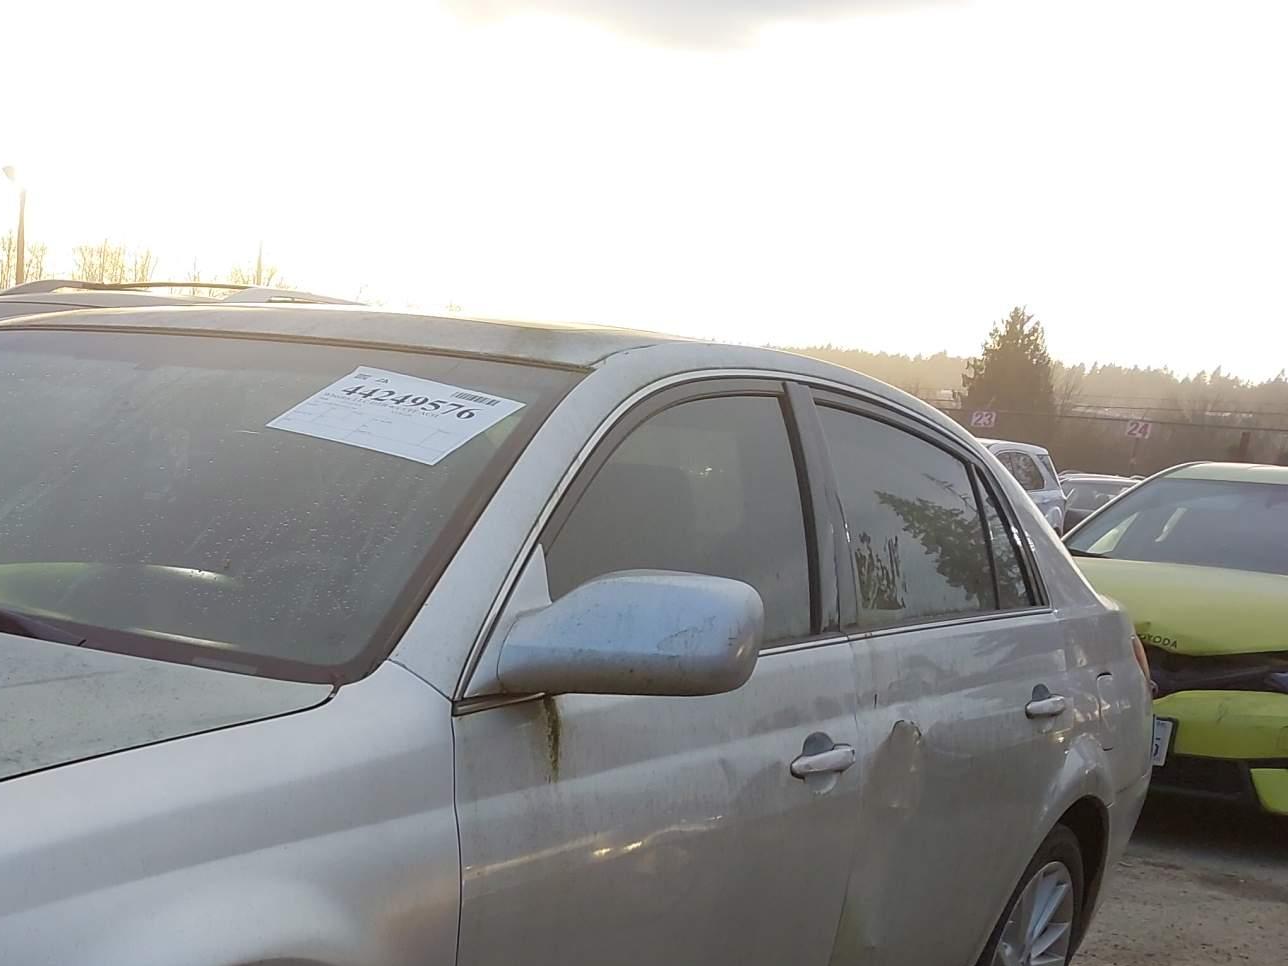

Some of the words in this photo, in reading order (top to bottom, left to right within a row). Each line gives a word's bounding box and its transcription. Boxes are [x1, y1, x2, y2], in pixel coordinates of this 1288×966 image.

[341, 385, 482, 420] 44249576
[974, 413, 994, 426] 23
[1128, 422, 1150, 437] 24
